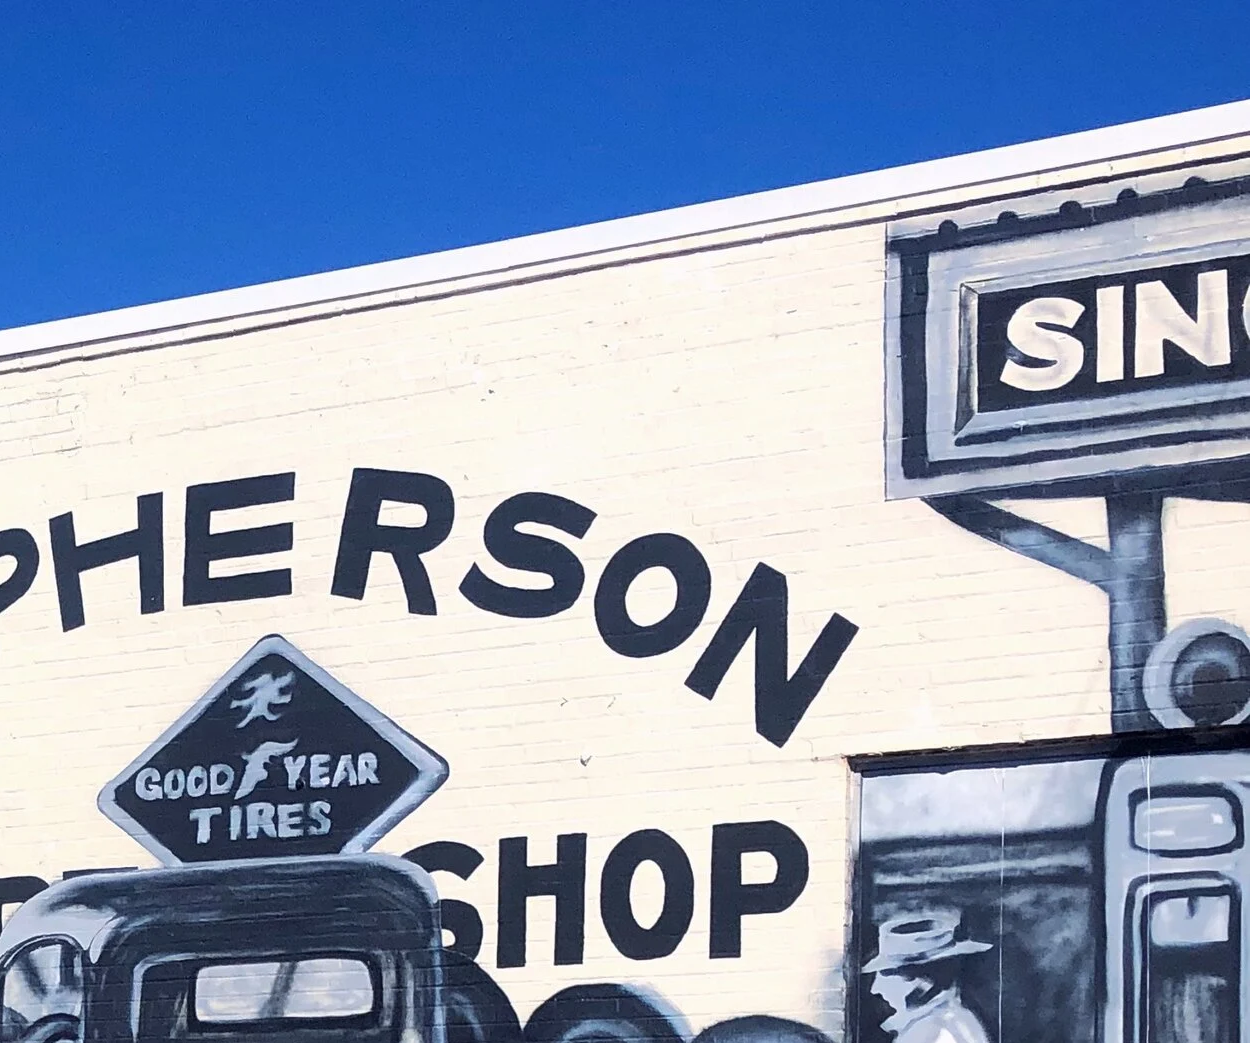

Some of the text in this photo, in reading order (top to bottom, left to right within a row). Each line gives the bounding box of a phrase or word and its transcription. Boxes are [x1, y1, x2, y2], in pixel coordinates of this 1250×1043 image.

[1000, 269, 1250, 391] SIN
[189, 800, 332, 845] TIRES
[401, 820, 809, 968] SHOP
